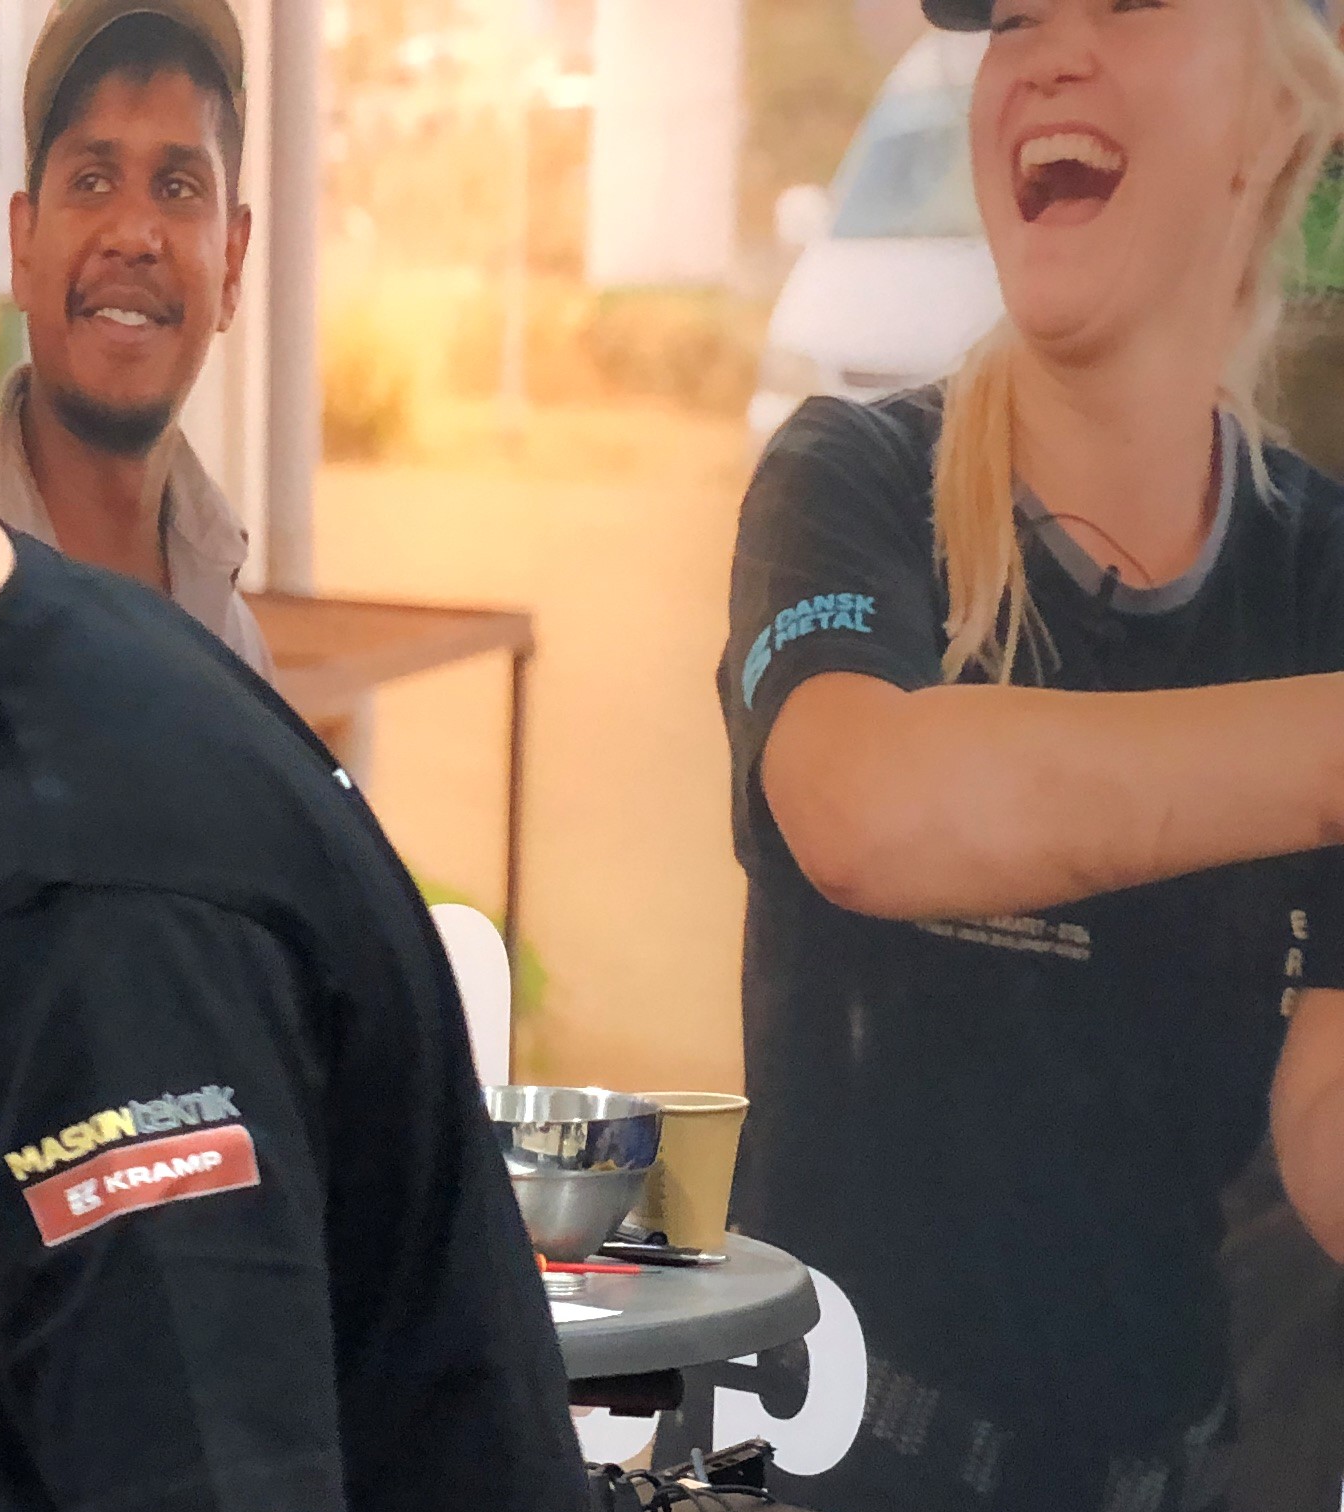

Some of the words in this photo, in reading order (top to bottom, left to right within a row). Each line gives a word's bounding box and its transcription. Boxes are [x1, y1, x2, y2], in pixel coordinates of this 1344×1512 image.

[773, 592, 877, 630] DANSK
[774, 611, 874, 652] METAL
[103, 1150, 223, 1194] KRAMP
